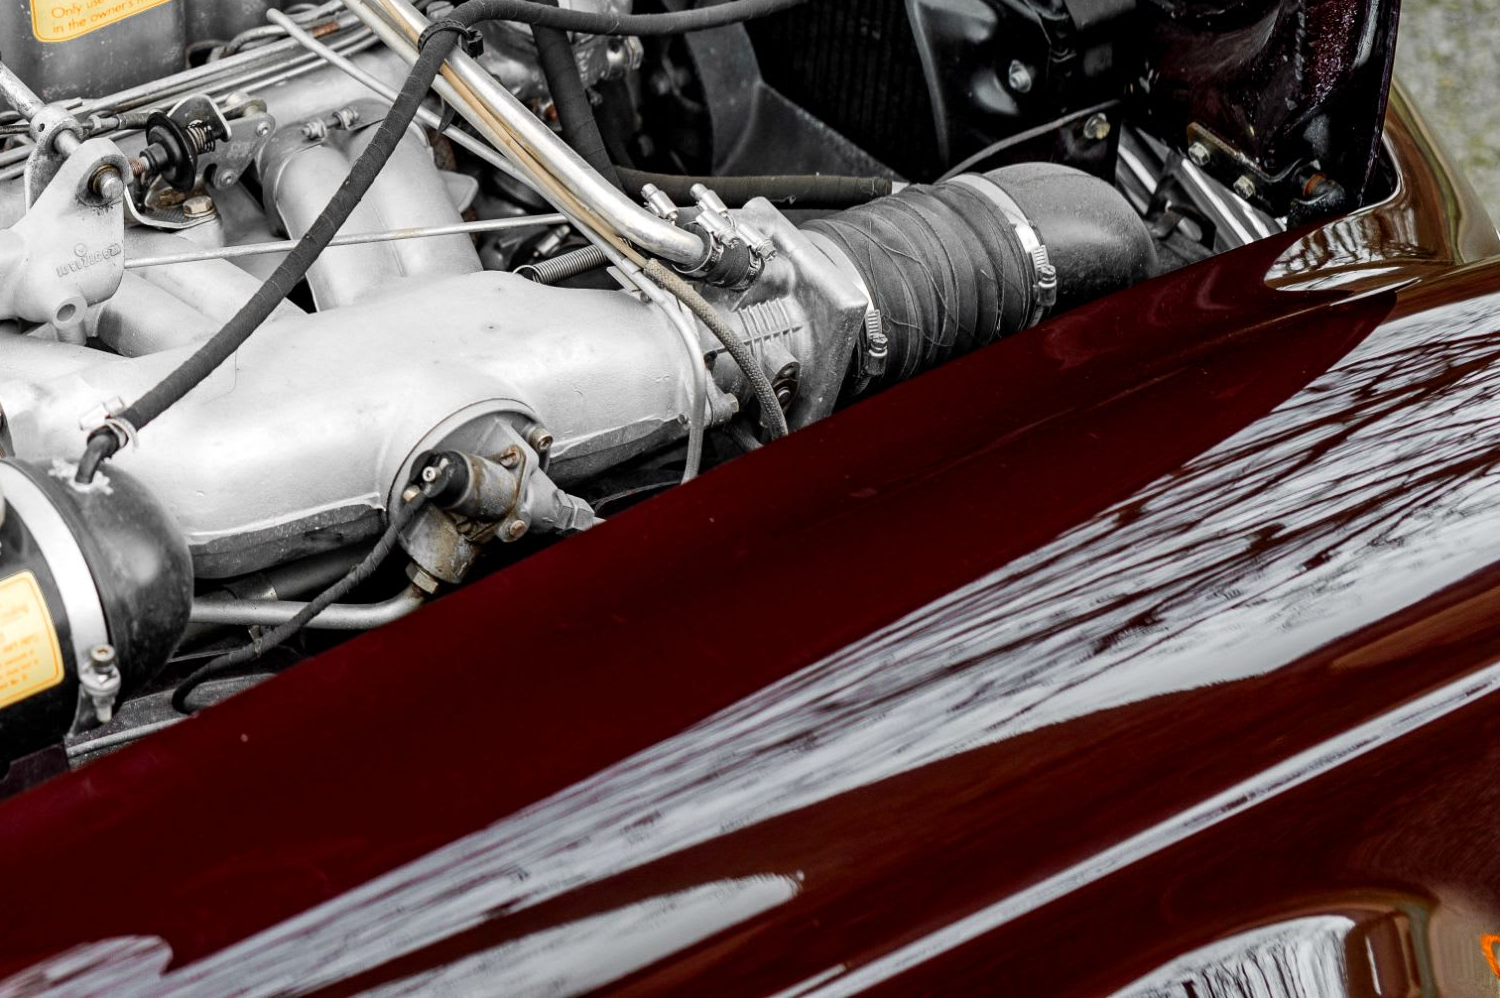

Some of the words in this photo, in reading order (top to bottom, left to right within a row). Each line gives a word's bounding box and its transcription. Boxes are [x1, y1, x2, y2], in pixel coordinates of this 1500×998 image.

[51, 3, 82, 19] Only
[52, 24, 64, 34] in
[68, 19, 87, 31] the
